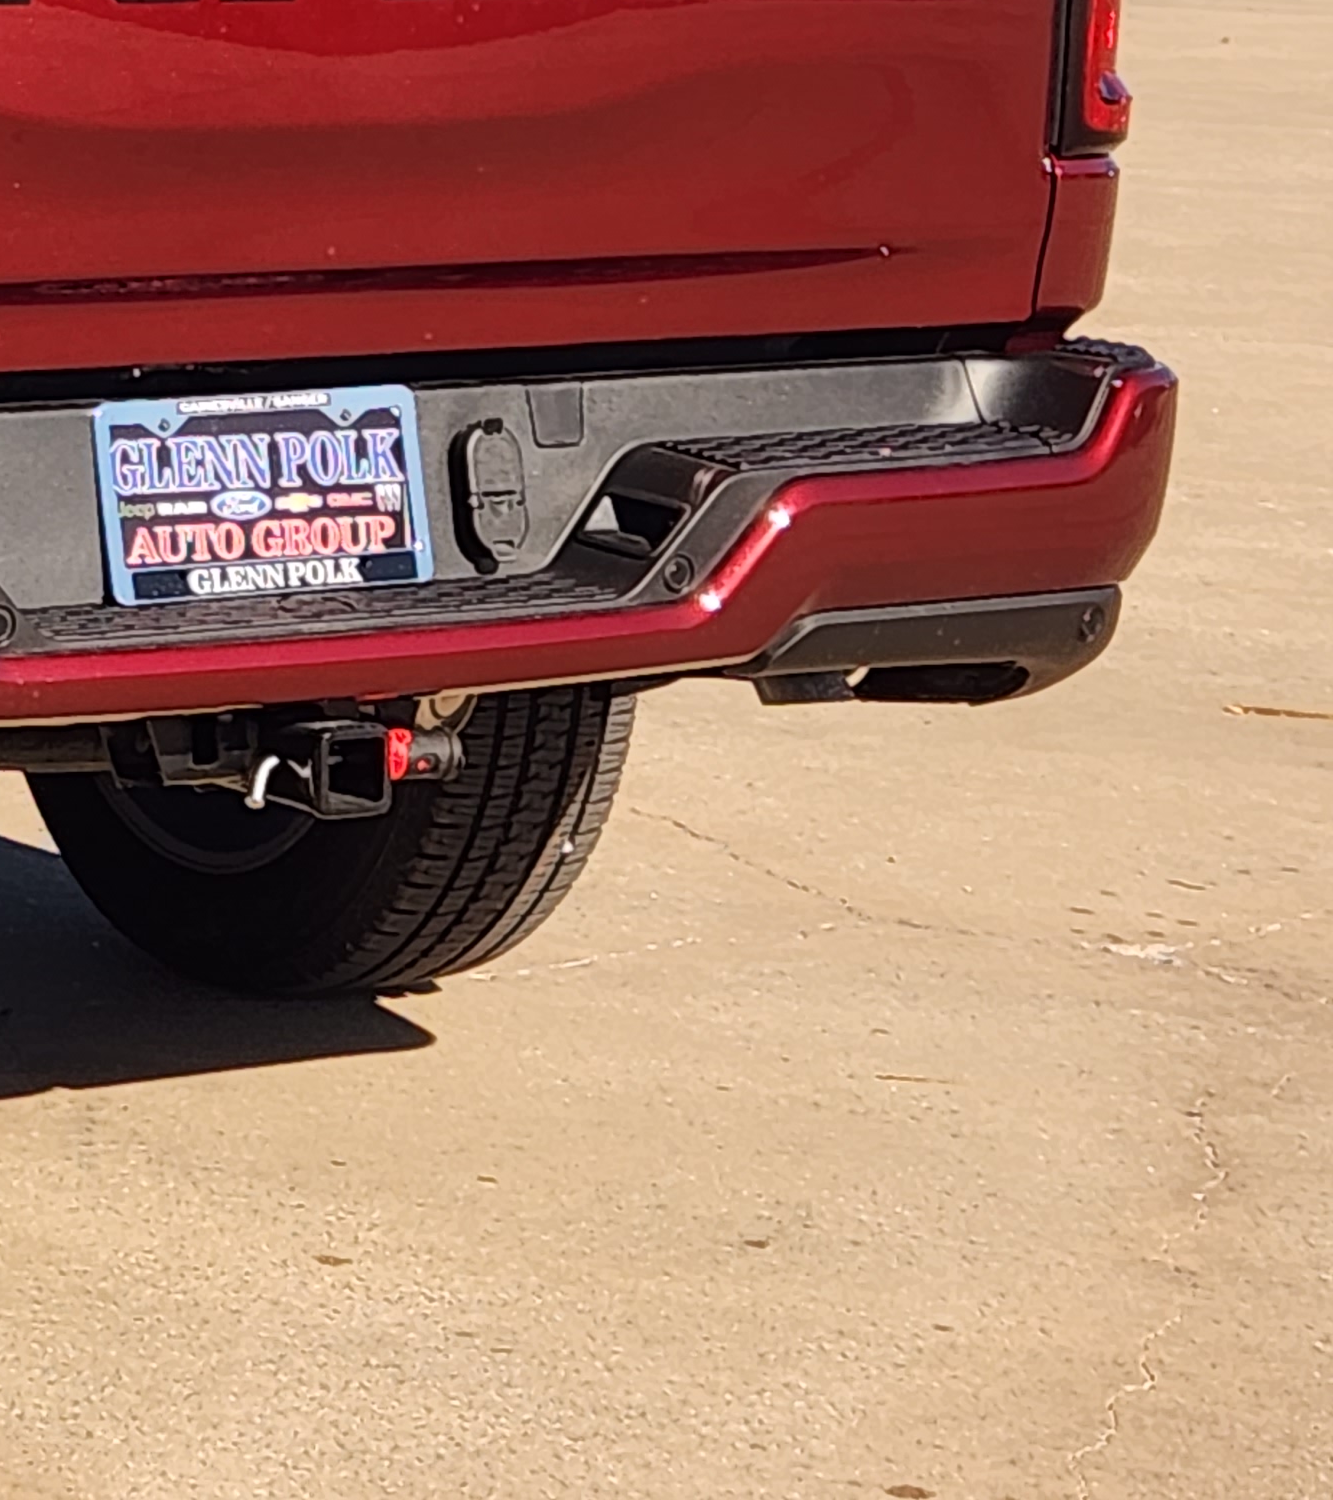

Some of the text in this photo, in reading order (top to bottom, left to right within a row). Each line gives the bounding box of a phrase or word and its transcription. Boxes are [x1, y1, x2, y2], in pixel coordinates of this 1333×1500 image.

[109, 427, 405, 496] GLENN POLK
[117, 501, 155, 520] Jeep
[126, 514, 397, 567] AUTO GROUP
[186, 556, 364, 596] GLENN POLK
